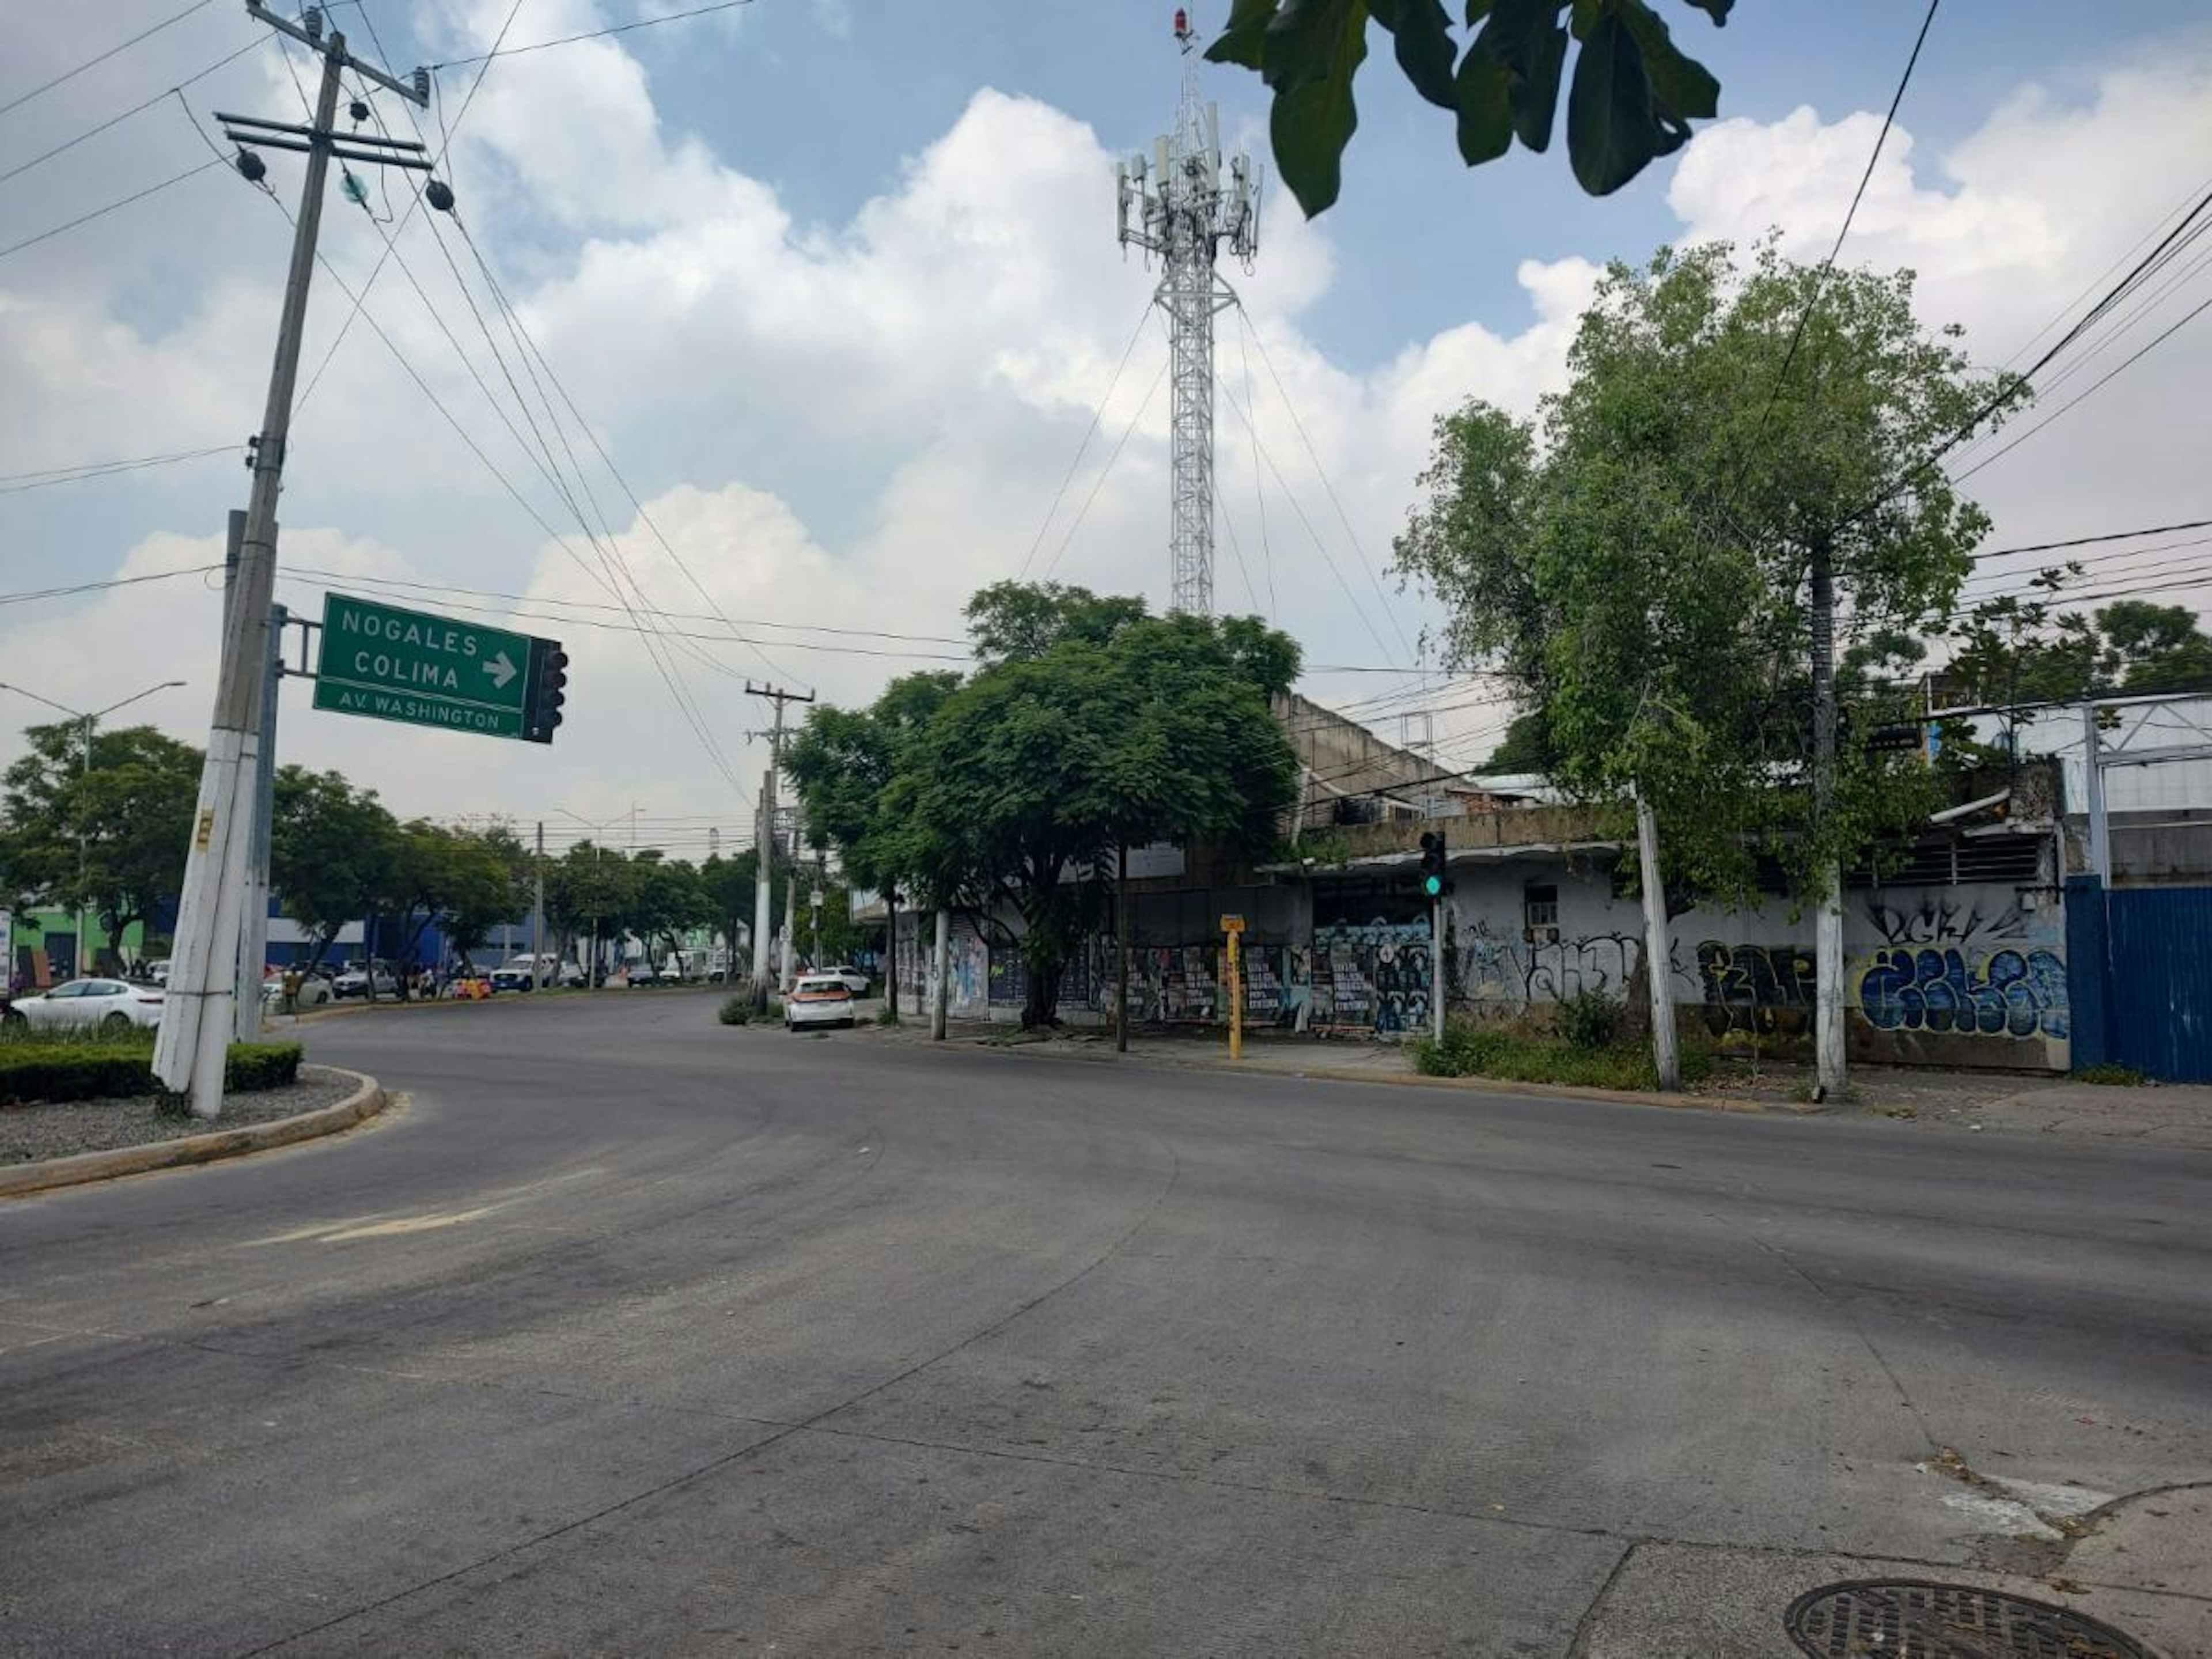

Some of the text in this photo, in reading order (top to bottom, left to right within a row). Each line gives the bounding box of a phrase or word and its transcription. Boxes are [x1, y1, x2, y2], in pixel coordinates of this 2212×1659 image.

[342, 610, 477, 656] NOGALES
[354, 652, 458, 689] COLIMA
[375, 696, 499, 729] WASHINGTON
